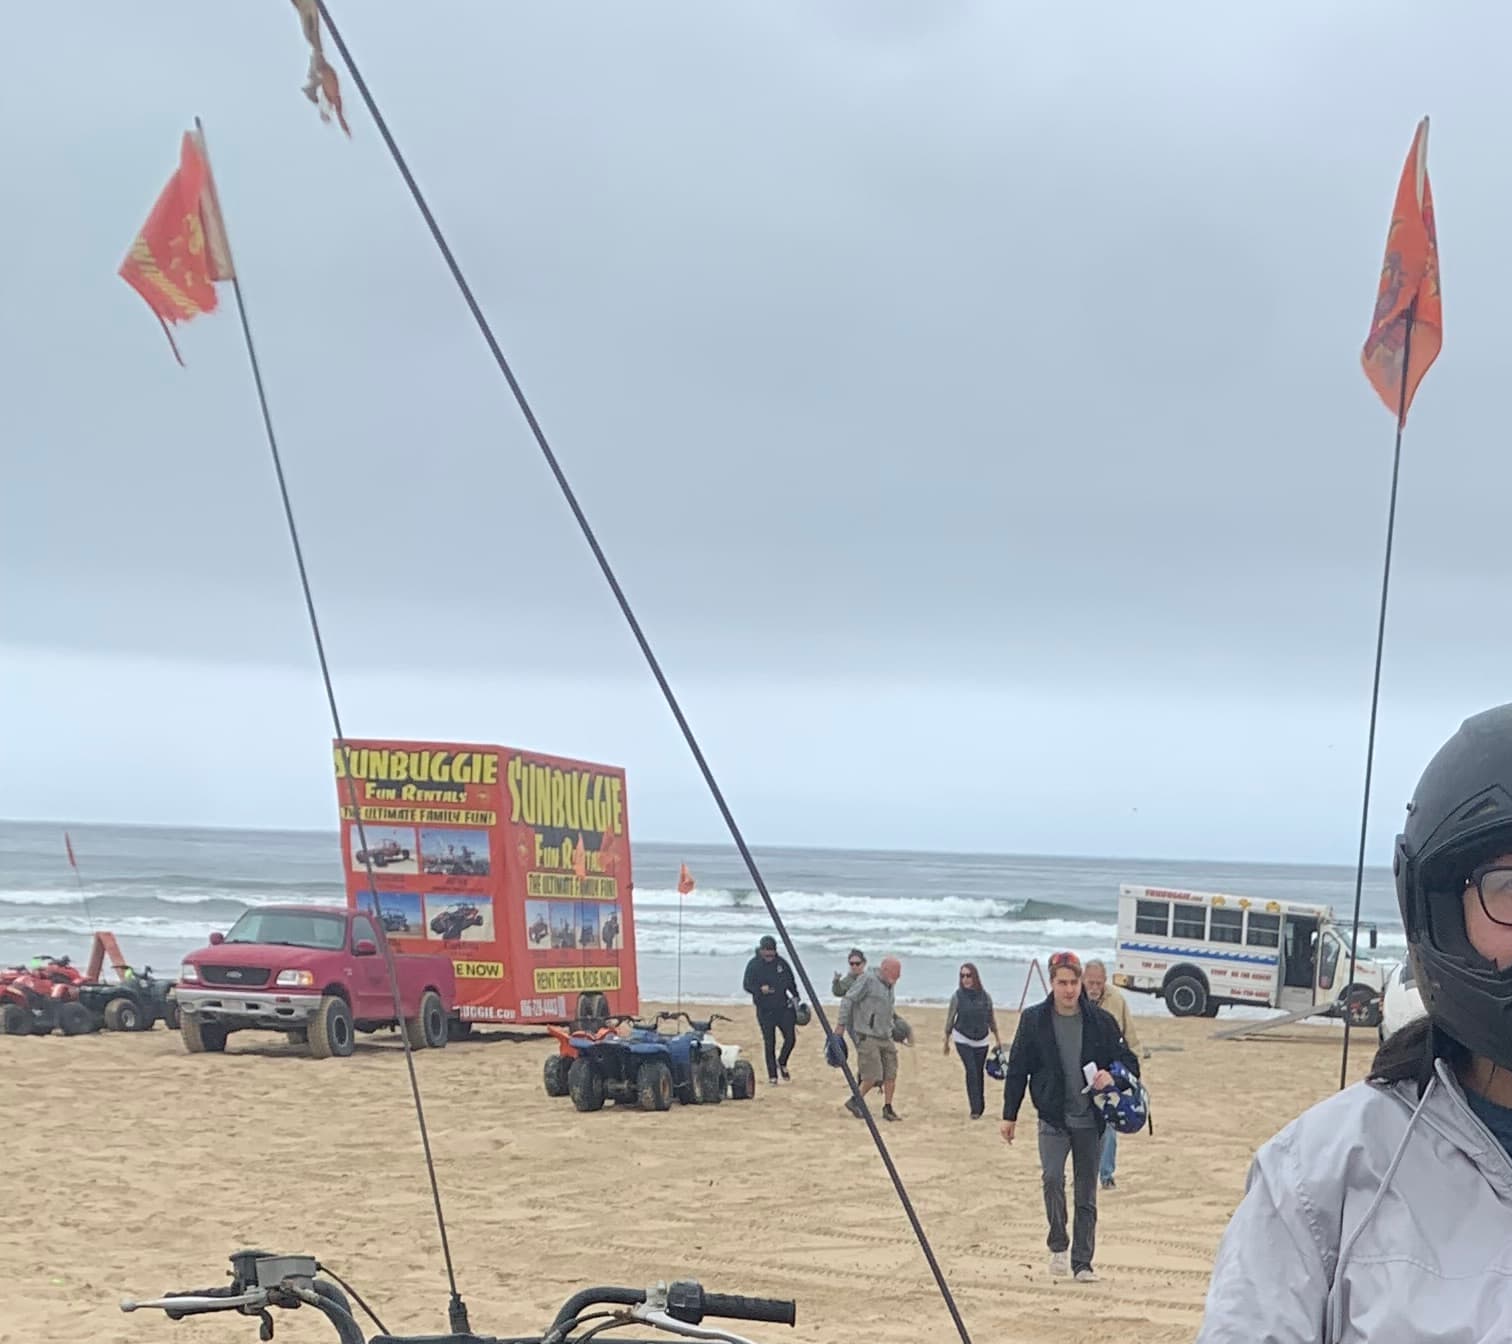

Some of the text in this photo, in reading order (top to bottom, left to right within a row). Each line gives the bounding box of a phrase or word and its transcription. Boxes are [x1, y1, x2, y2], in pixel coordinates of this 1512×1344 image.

[365, 782, 467, 803] FUN RENTALS
[508, 755, 622, 835] SUNBUGGIE
[365, 808, 415, 821] ULTIMATE
[420, 811, 461, 823] FAMILY
[535, 833, 559, 868] FUN
[466, 964, 499, 976] NOW
[536, 971, 555, 989] RENT
[558, 971, 575, 988] HERE
[600, 970, 618, 987] NOW
